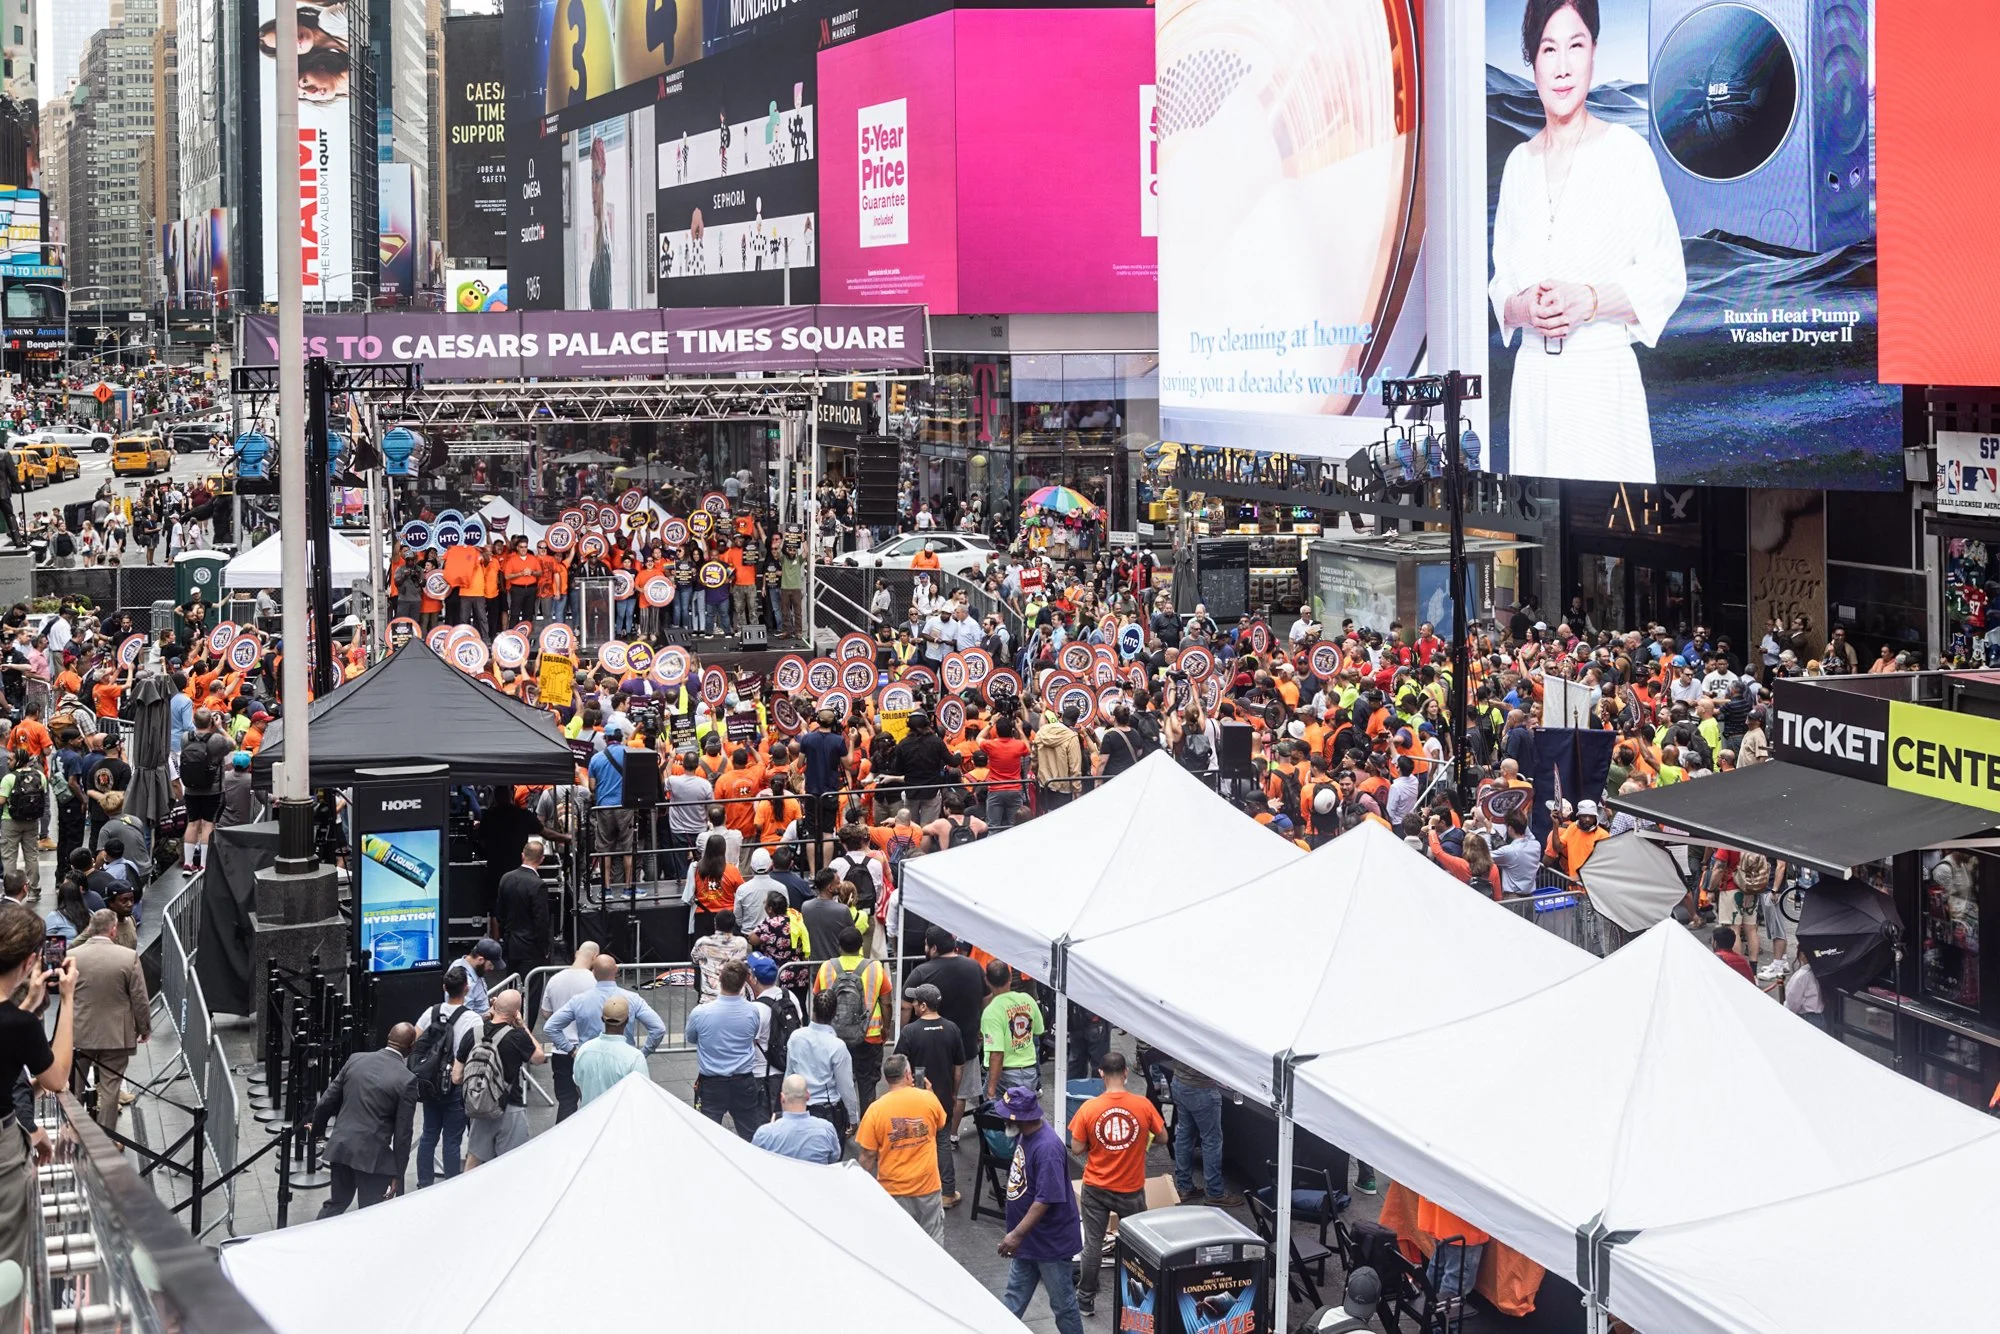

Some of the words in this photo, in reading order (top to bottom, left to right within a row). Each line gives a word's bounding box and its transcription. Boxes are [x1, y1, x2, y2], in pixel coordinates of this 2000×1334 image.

[831, 9, 859, 26] MARRIOTT
[831, 24, 856, 40] MARQUIS
[666, 70, 684, 84] MARRIOTT
[666, 82, 682, 94] MARQUIS
[320, 128, 329, 166] QUIT
[862, 123, 904, 154] 5-Year
[476, 166, 494, 174] JOBS
[862, 156, 904, 190] Price
[320, 174, 330, 222] ALBUM
[522, 181, 542, 200] OMEGA
[713, 190, 746, 210] SEPHORA
[298, 128, 318, 286] HAIM
[862, 192, 906, 210] Guarantee
[873, 214, 894, 227] included
[320, 228, 330, 256] NEW
[521, 223, 542, 242] swatch
[526, 276, 540, 301] 1965
[1724, 308, 1768, 324] Ruxin
[1772, 308, 1809, 324] Heat
[1812, 308, 1860, 326] Pump
[336, 336, 382, 360] TO
[392, 333, 539, 359] CAESARS
[548, 330, 668, 357] PALACE
[677, 327, 772, 354] TIMES
[782, 325, 905, 353] SQUARE
[1190, 332, 1215, 360] Dry
[1218, 324, 1287, 356] cleaning
[1291, 326, 1308, 348] at
[1314, 318, 1372, 347] home
[1730, 327, 1789, 343] Washer
[1792, 328, 1838, 347] Dryer
[1162, 370, 1198, 398] saving
[1200, 376, 1224, 398] you
[1227, 378, 1236, 394] a
[1239, 369, 1304, 394] decade's
[1307, 368, 1363, 396] worth
[1367, 366, 1392, 396] of
[818, 404, 862, 426] SEPHORA
[1980, 436, 2000, 460] SP
[1955, 500, 1982, 508] LICENSED
[407, 532, 427, 540] HTC
[439, 534, 458, 543] HTC
[1766, 552, 1812, 576] live
[1021, 570, 1040, 579] NO
[1755, 577, 1820, 602] your
[1124, 636, 1138, 648] HTC
[1777, 710, 1886, 766] TICKET
[1892, 735, 2000, 792] CENTE
[382, 799, 422, 811] HOPE
[391, 852, 414, 872] LIQUID
[364, 912, 436, 924] HYDRATION
[1104, 1117, 1130, 1141] PAC
[1183, 1284, 1218, 1294] LONDON'S
[1218, 1280, 1237, 1289] WEST
[1239, 1278, 1252, 1286] END
[1120, 1306, 1154, 1332] AMAZE
[1196, 1310, 1256, 1334] MAZE
